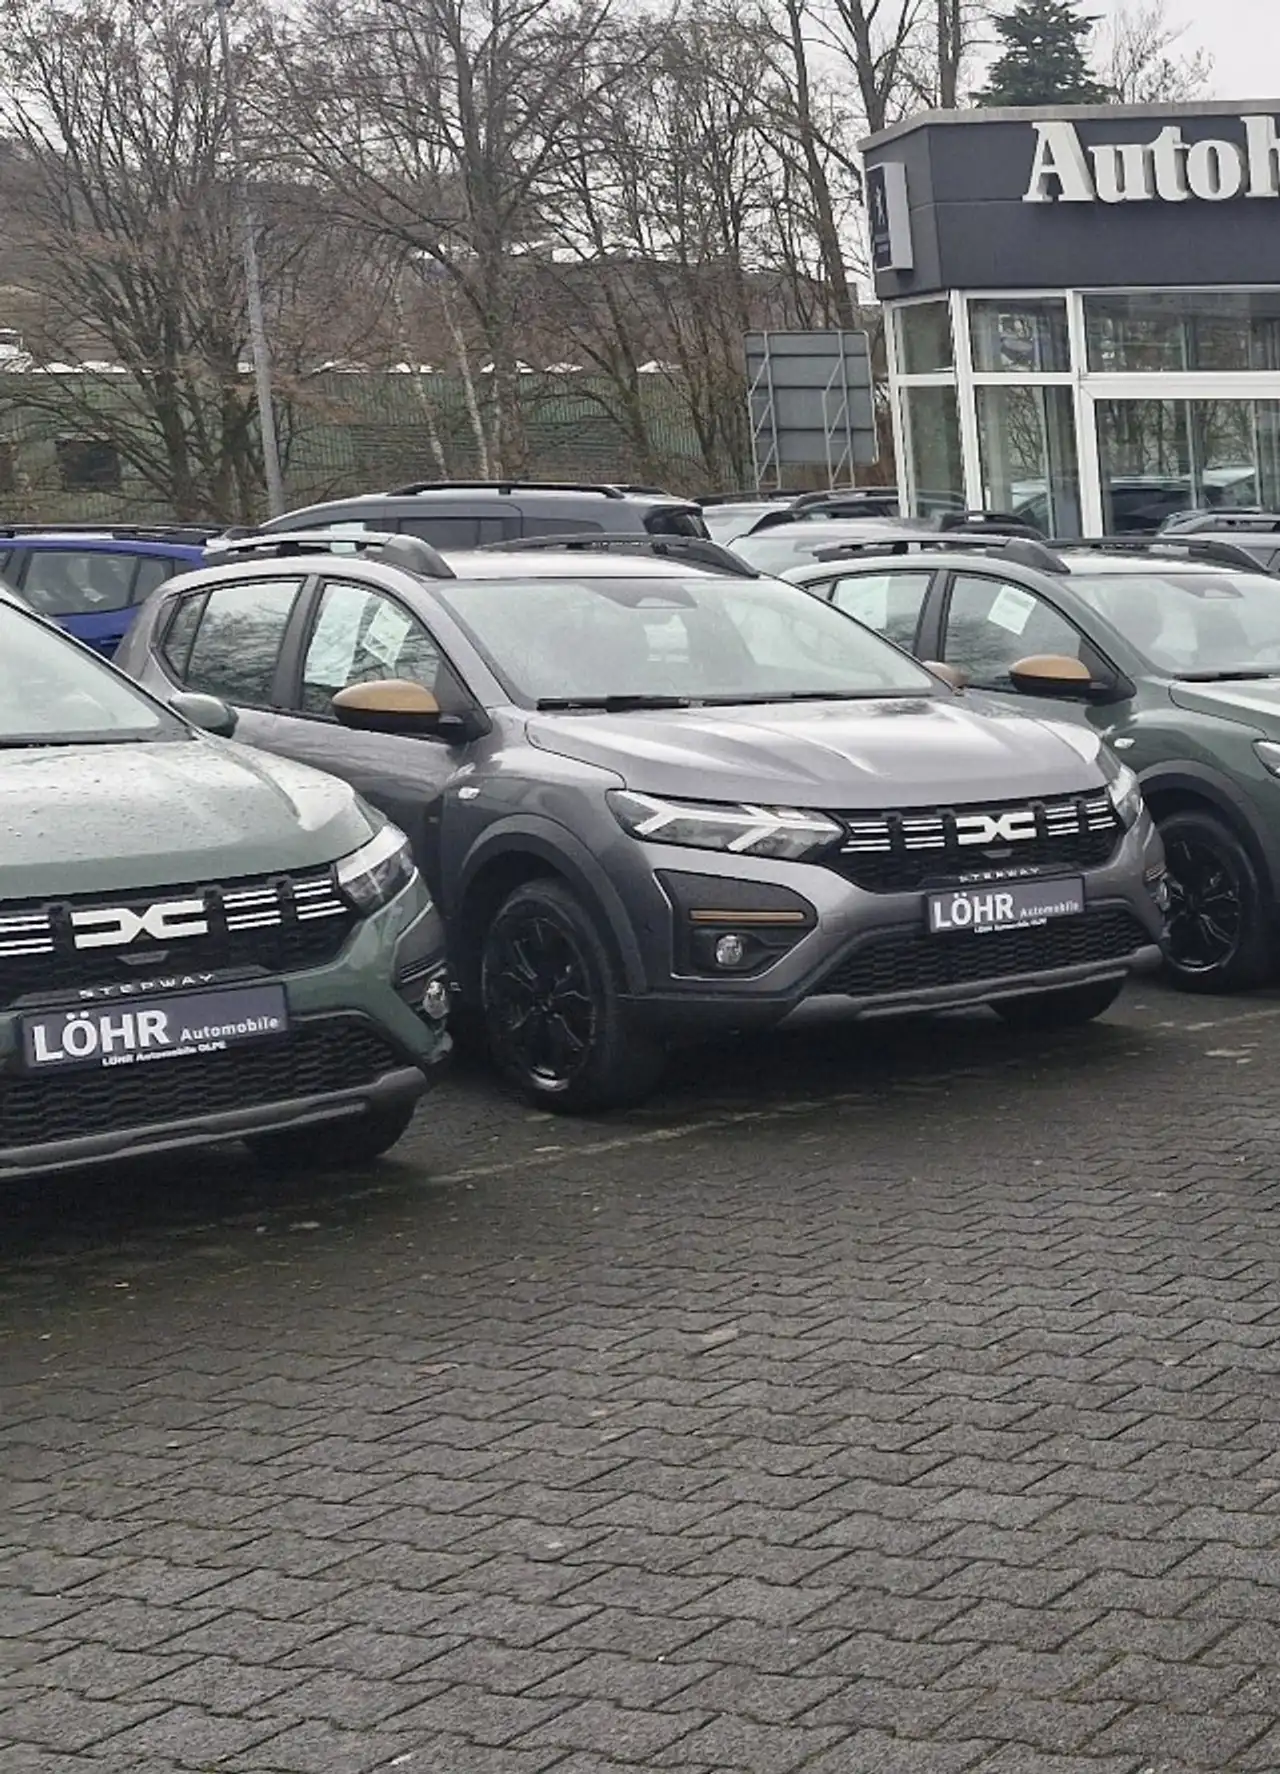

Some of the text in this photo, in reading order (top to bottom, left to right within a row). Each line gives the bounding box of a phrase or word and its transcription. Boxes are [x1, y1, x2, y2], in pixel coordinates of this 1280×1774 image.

[933, 892, 1015, 929] LÖHR
[78, 973, 215, 999] STEPWAY
[32, 1009, 280, 1062] LÖHR Automobile
